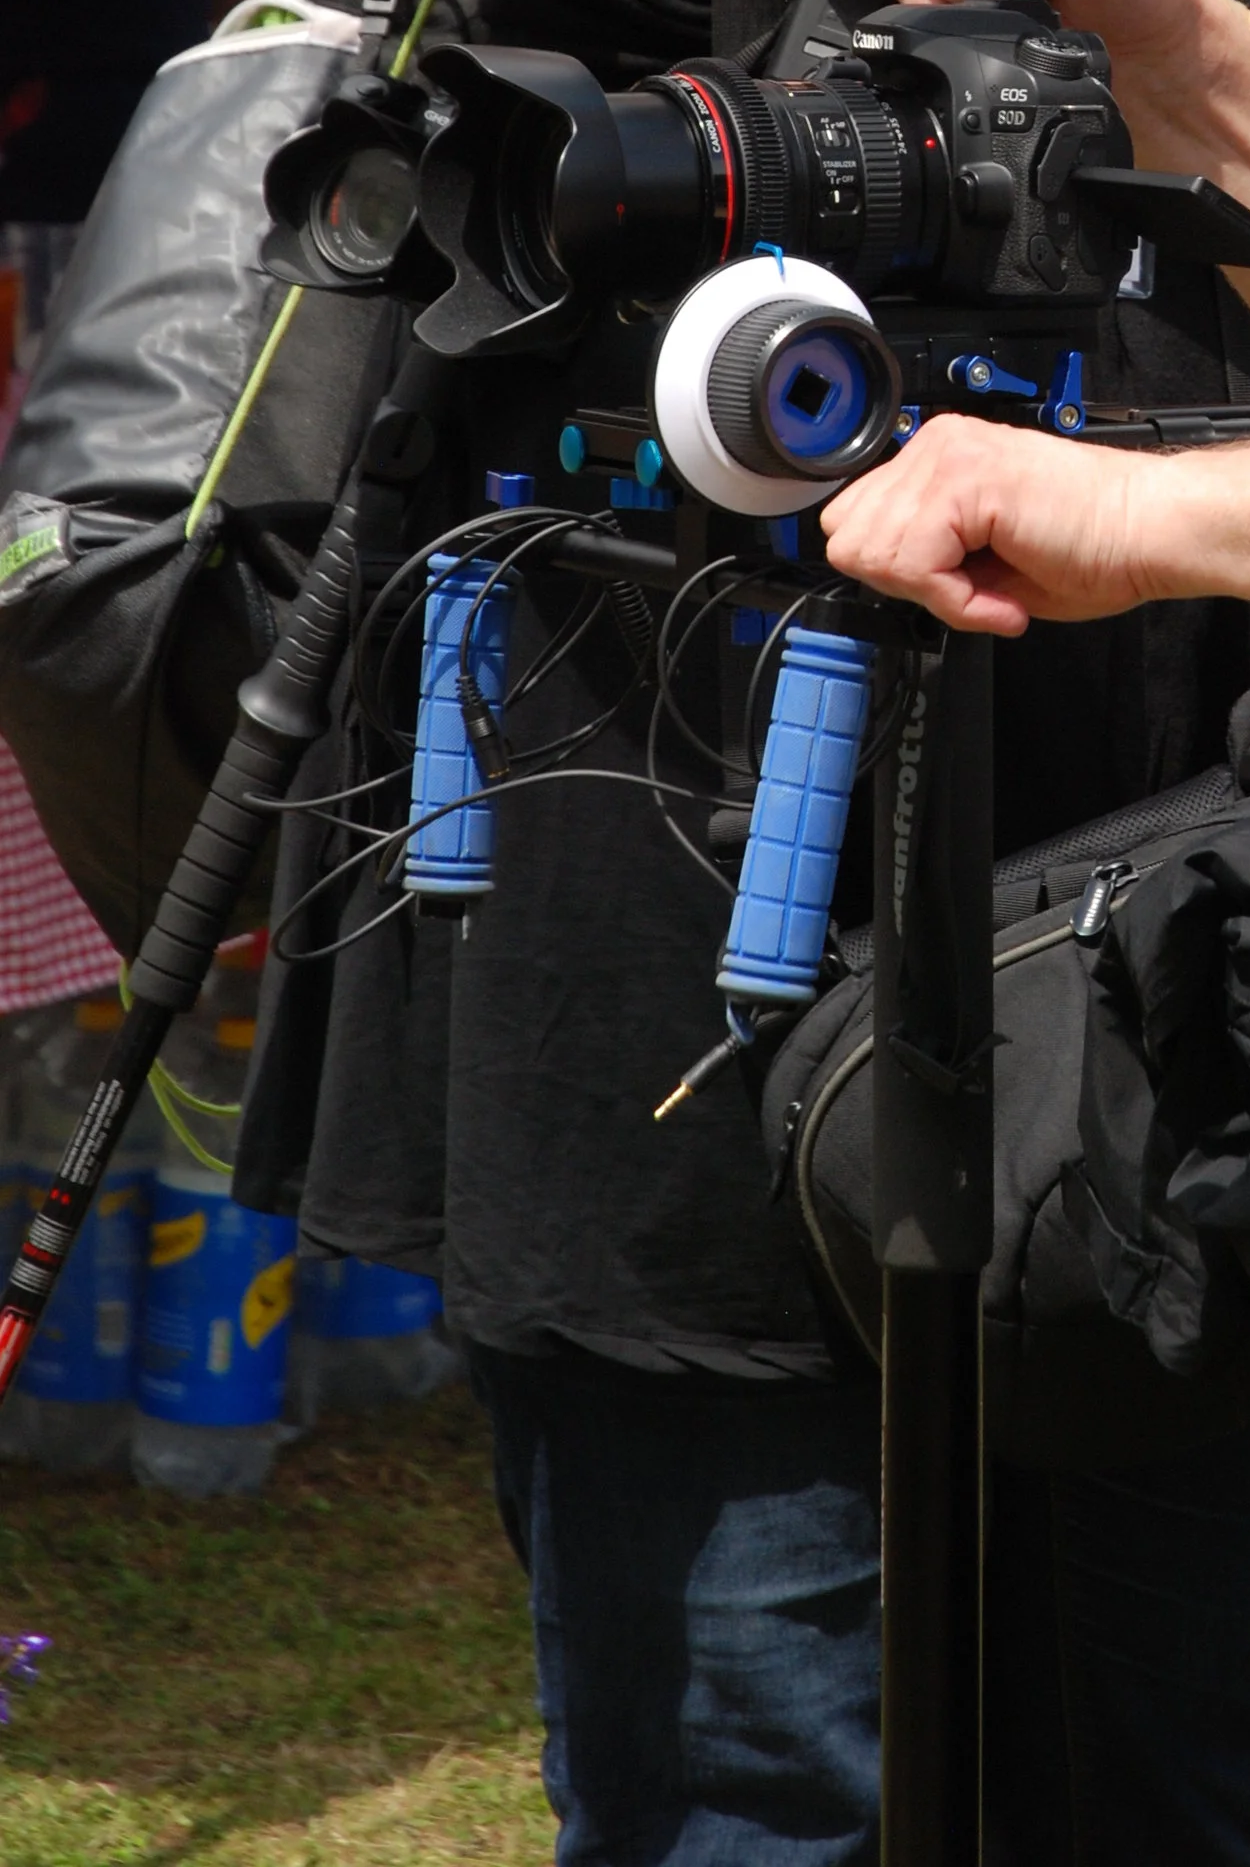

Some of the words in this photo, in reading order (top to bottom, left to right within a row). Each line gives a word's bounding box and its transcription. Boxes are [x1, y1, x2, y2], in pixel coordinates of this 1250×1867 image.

[852, 29, 894, 51] Canon
[1000, 87, 1028, 103] EOS
[691, 92, 709, 115] ZOOM
[997, 109, 1026, 126] 80D
[705, 119, 721, 154] CANON
[822, 160, 857, 169] STABILIZER
[825, 169, 837, 177] ON
[841, 175, 855, 183] OFF
